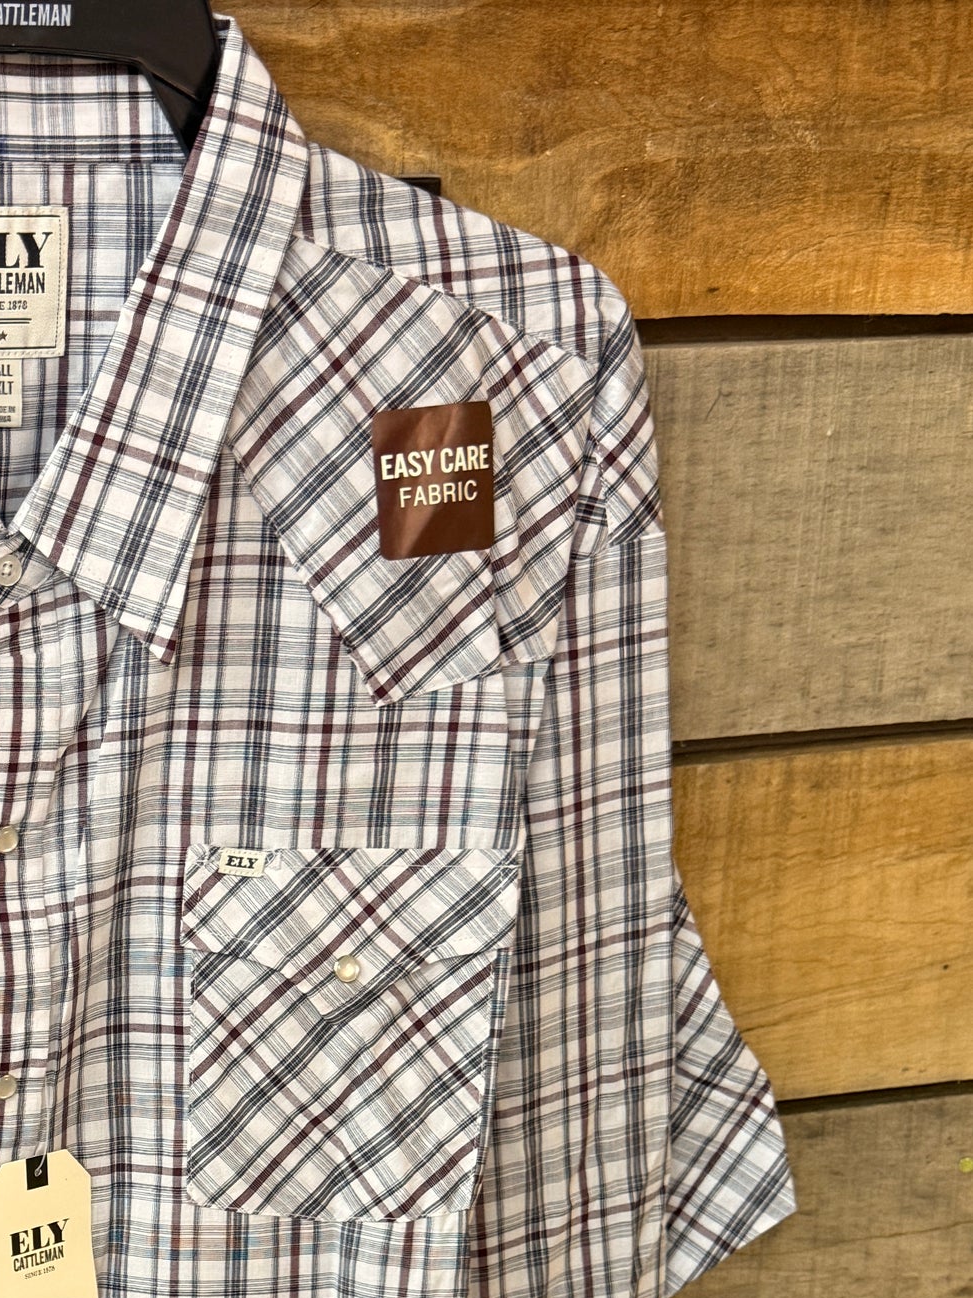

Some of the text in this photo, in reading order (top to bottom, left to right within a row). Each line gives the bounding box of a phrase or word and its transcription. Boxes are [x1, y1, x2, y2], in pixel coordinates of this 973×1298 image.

[8, 299, 28, 310] 1878
[380, 444, 489, 481] EASY CARE
[399, 480, 478, 508] FABRIC
[226, 855, 259, 869] ELY
[9, 1218, 69, 1257] ELY
[13, 1245, 64, 1272] CATTLEMAN
